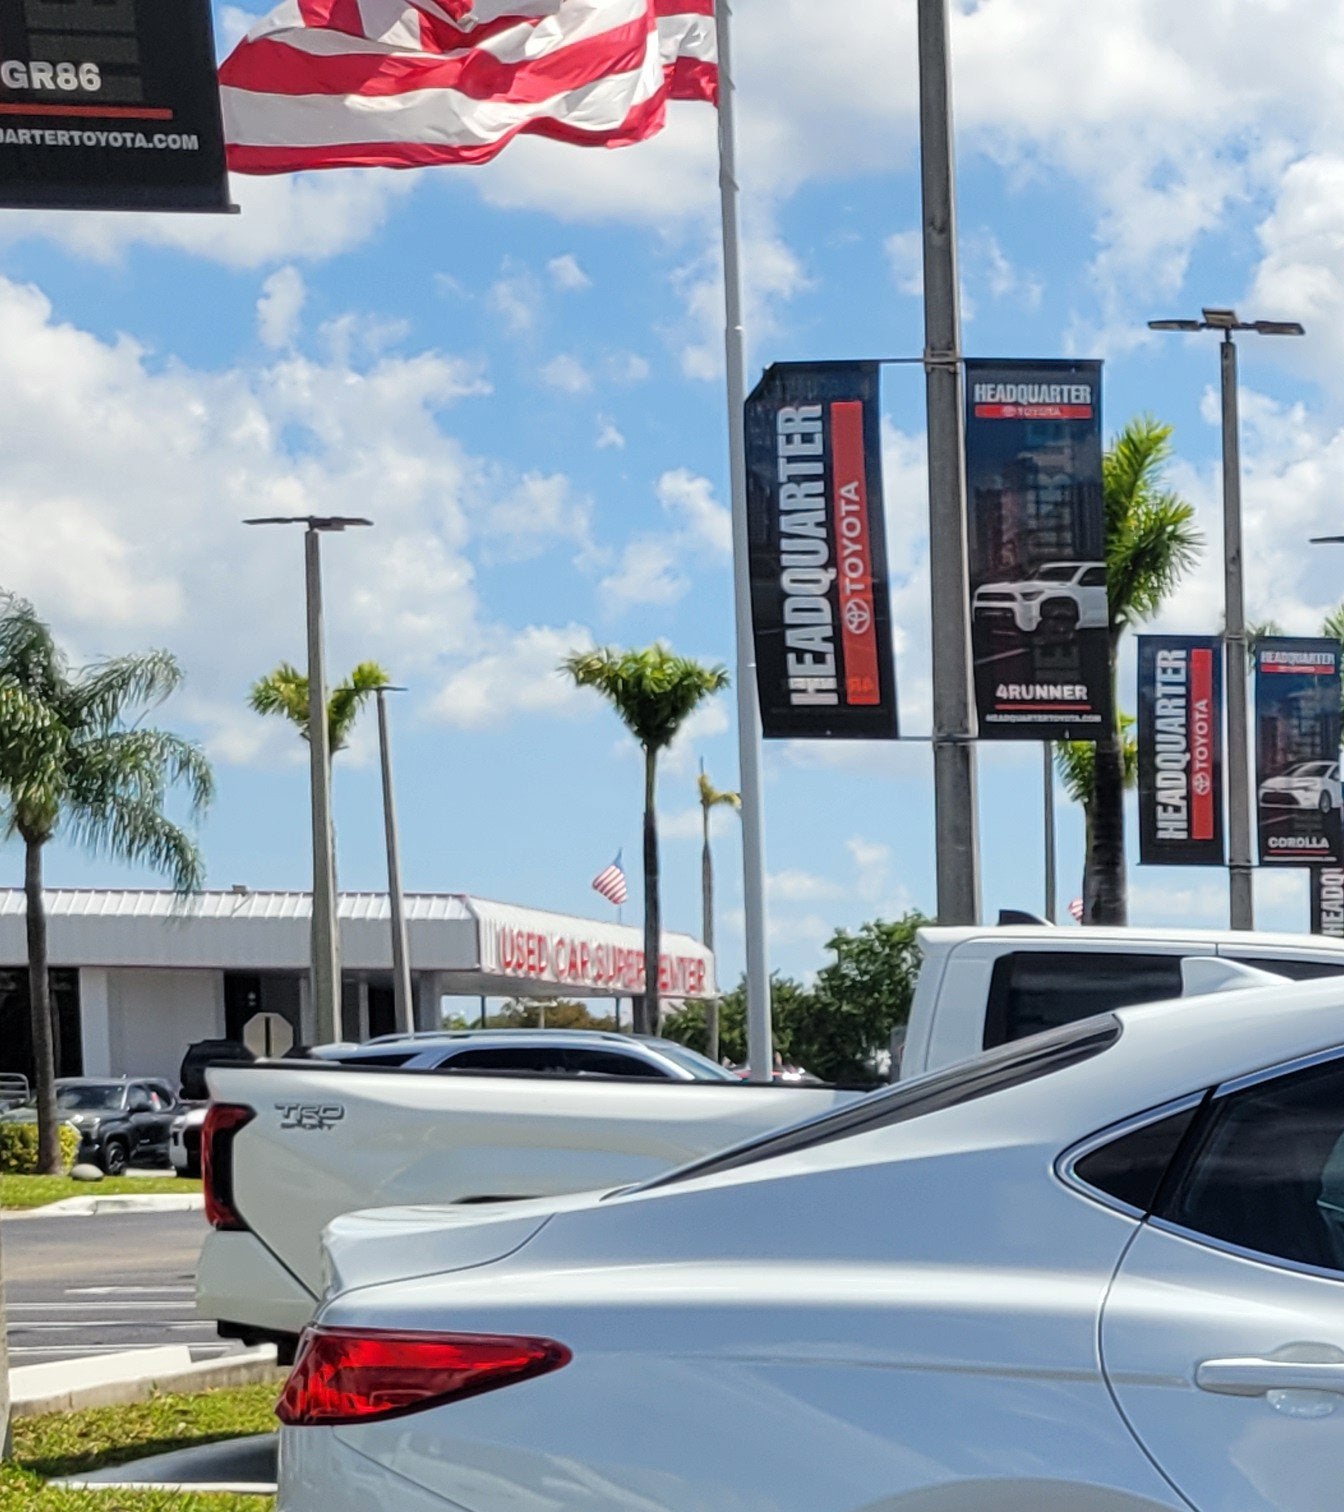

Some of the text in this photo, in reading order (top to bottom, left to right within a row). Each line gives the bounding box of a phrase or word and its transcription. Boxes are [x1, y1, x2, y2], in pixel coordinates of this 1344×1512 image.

[1, 60, 102, 91] GR86
[975, 383, 1092, 405] HEADQUARTER
[777, 404, 839, 705] HEADQUARTER
[839, 480, 867, 594] TOYOTA
[995, 684, 1088, 700] 4RUNNER
[1155, 649, 1191, 840] HEADQUARTER
[1193, 699, 1209, 775] TOYOTA
[1267, 836, 1330, 849] COROLLA
[502, 927, 549, 974] USED
[556, 937, 589, 979] CAR
[275, 1103, 345, 1125] TRD
